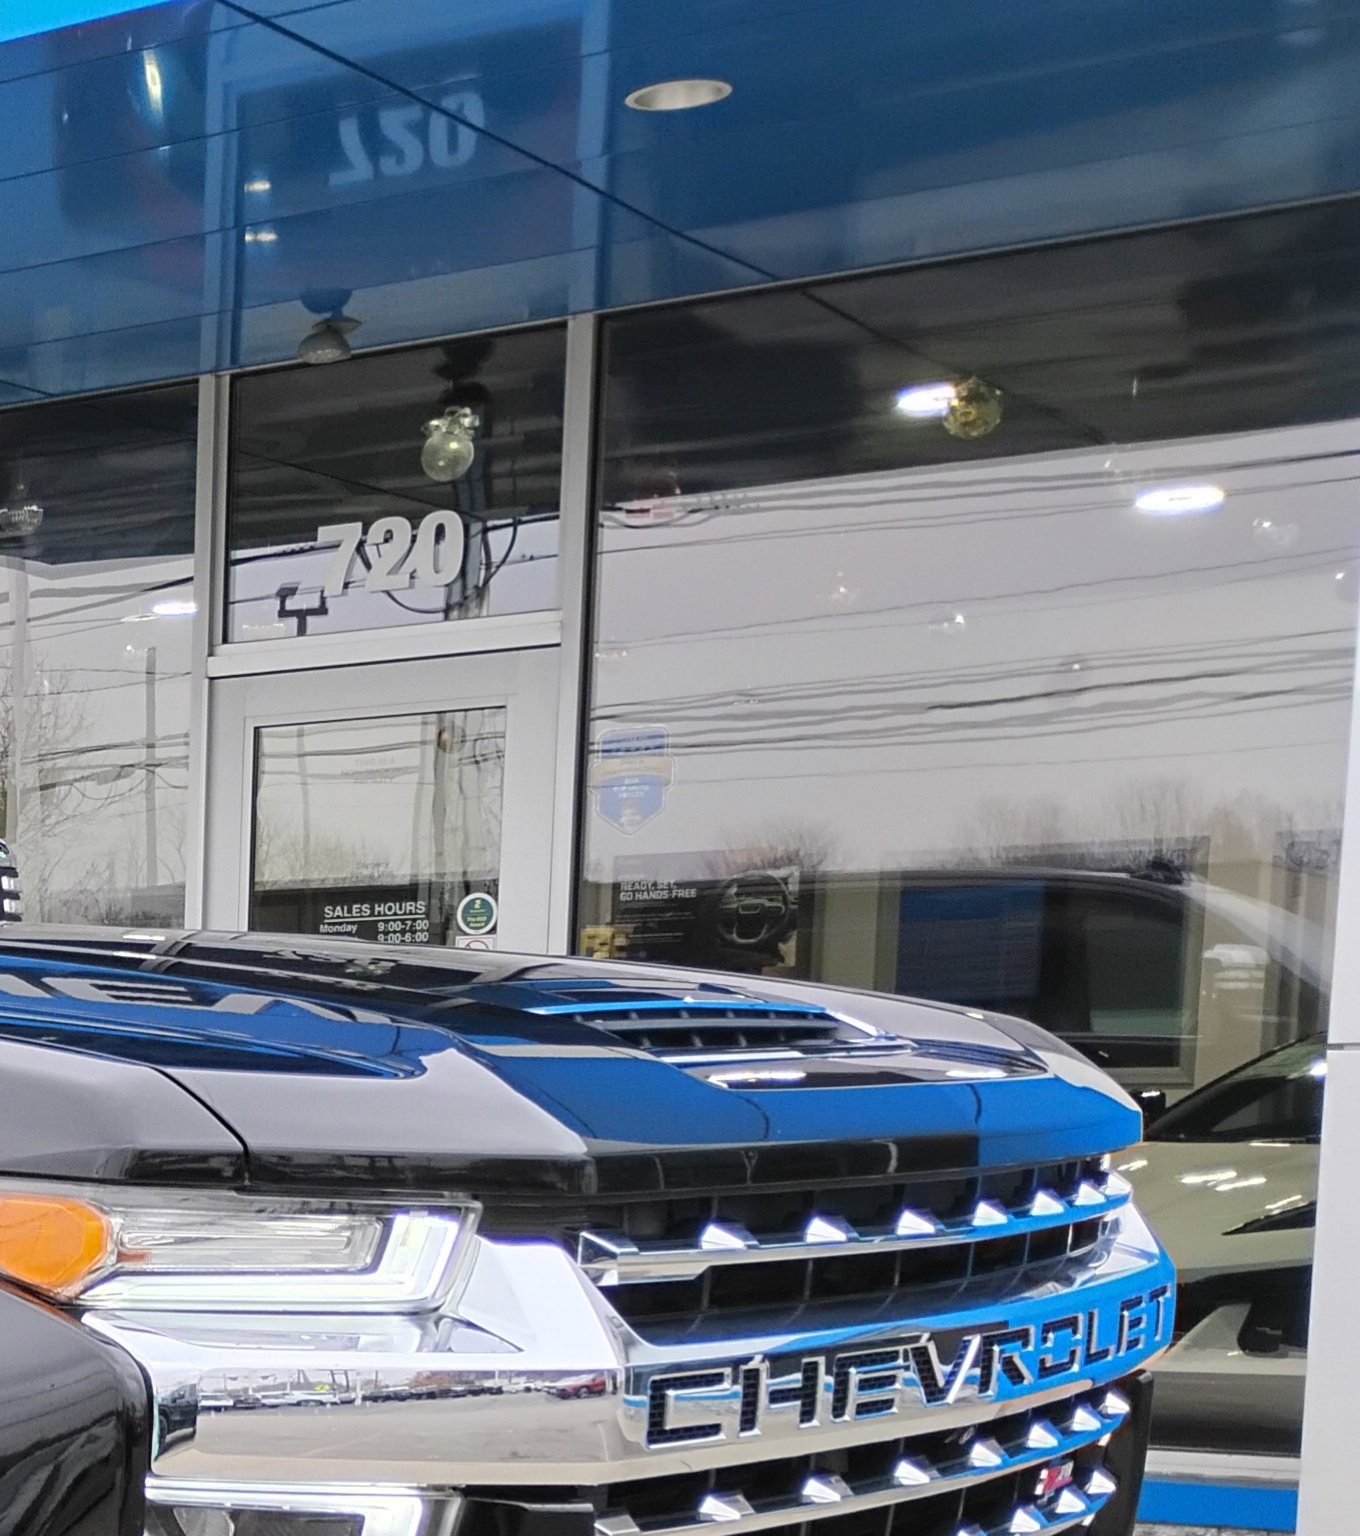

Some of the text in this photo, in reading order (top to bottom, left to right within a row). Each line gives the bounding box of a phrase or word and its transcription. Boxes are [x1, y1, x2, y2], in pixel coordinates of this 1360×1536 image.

[317, 510, 464, 598] 720
[320, 920, 429, 933] Monday 9:00-7:00
[324, 901, 426, 918] SALES HOURS
[645, 1284, 1171, 1450] CHEVROLET
